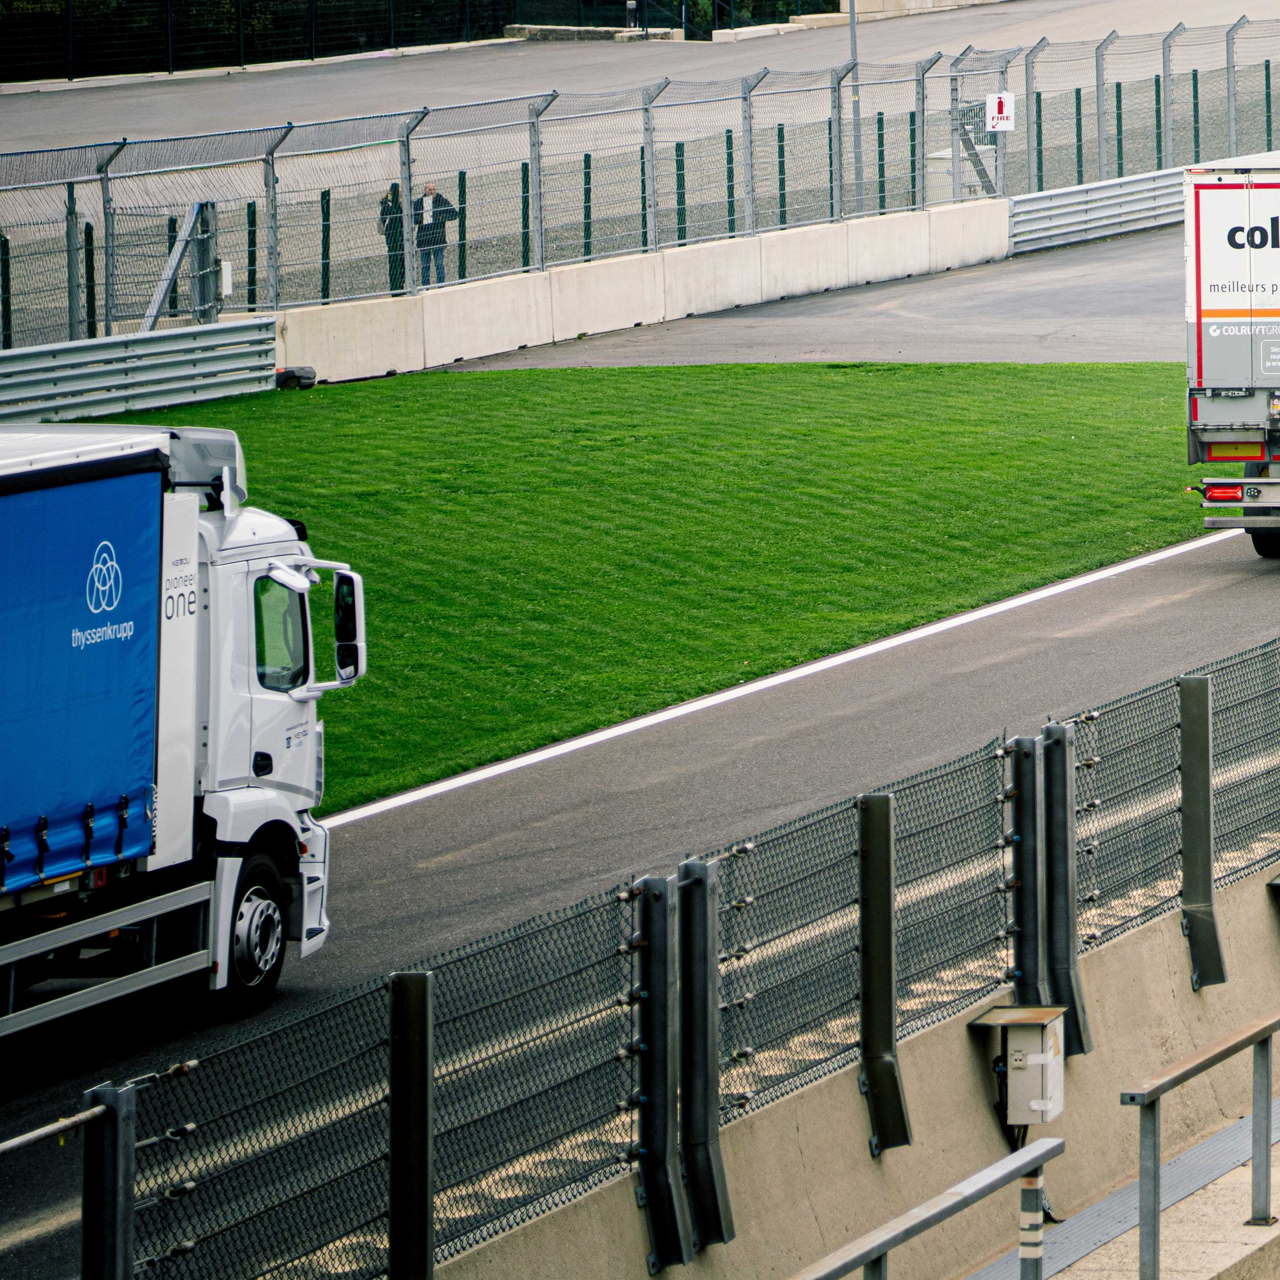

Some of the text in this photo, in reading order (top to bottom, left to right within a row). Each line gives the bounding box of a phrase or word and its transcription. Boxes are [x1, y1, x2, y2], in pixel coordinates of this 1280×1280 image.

[1209, 280, 1267, 293] meilleurs
[164, 590, 197, 620] one
[71, 621, 135, 650] thyssenkrupp
